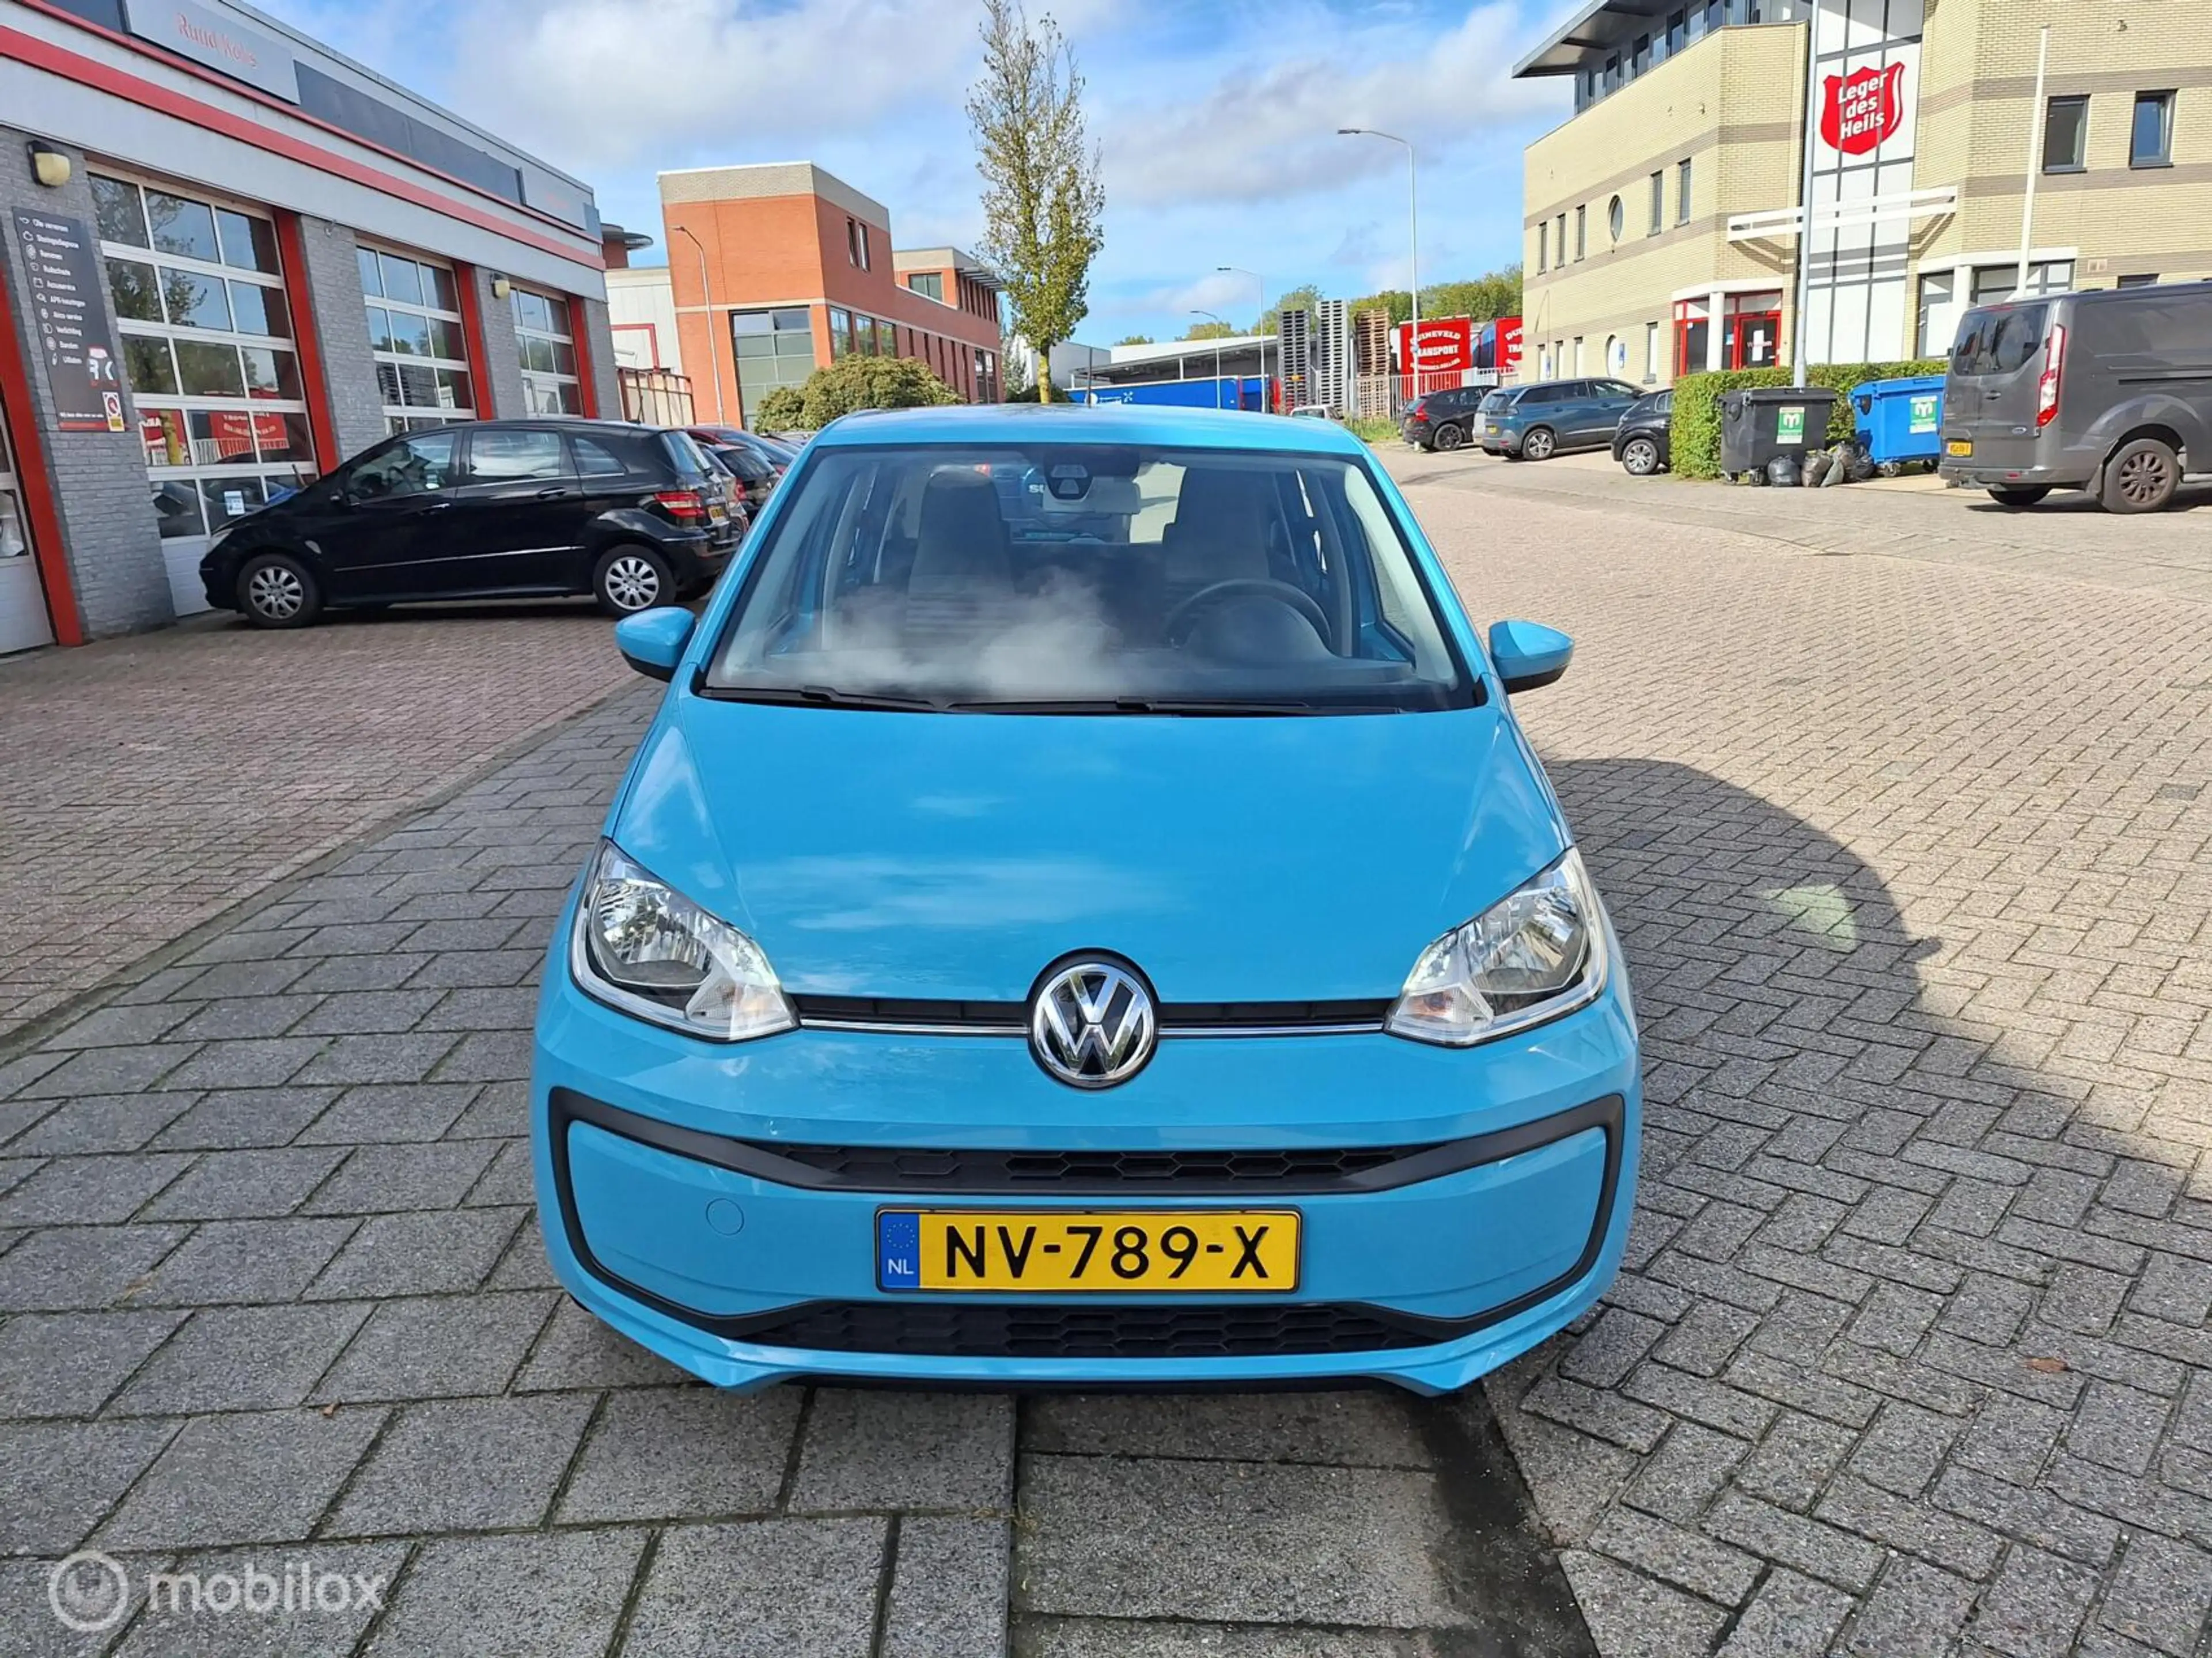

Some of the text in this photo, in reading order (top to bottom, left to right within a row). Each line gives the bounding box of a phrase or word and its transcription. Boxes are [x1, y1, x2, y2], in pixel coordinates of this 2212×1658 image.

[1838, 73, 1888, 104] Leger
[1846, 96, 1877, 119] des
[1840, 112, 1885, 140] Heils
[887, 1225, 1270, 1279] NL NV-789-X
